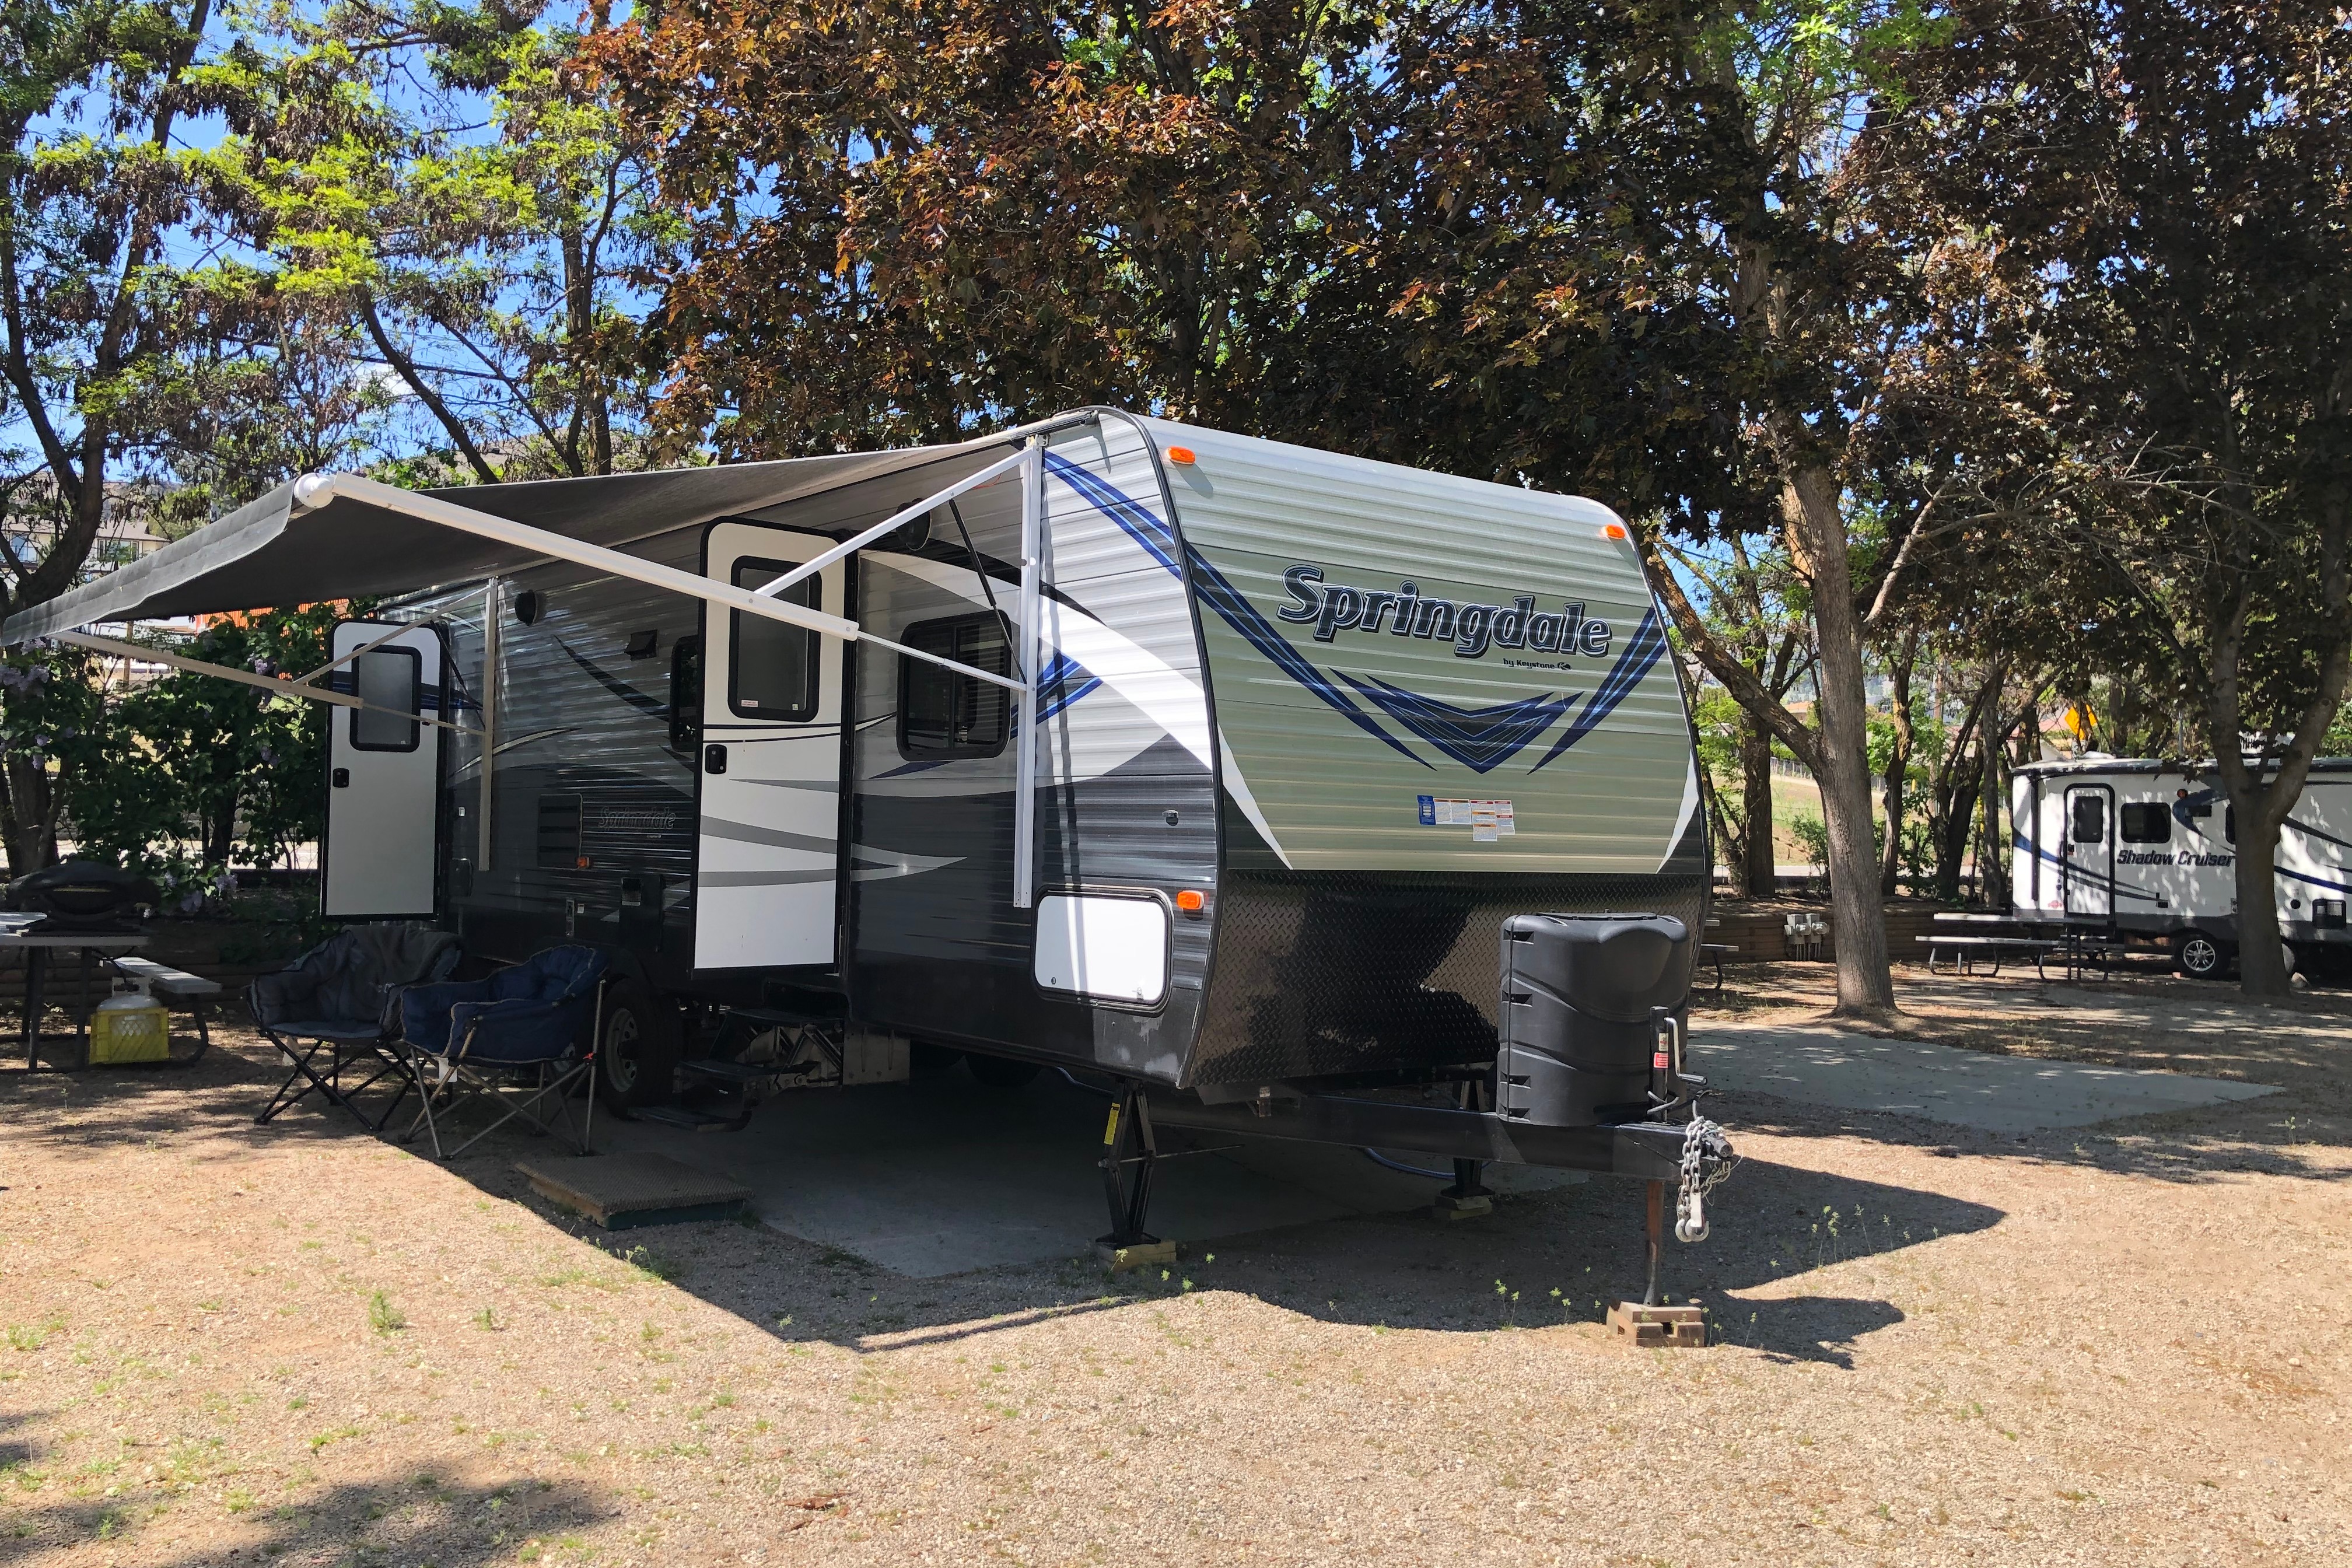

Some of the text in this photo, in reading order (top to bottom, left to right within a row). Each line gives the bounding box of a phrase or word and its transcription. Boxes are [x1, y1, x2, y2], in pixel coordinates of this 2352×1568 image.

[1276, 564, 1612, 658] Springdale
[1503, 658, 1555, 669] by Keystone
[2117, 849, 2236, 867] Shadow Cruiser
